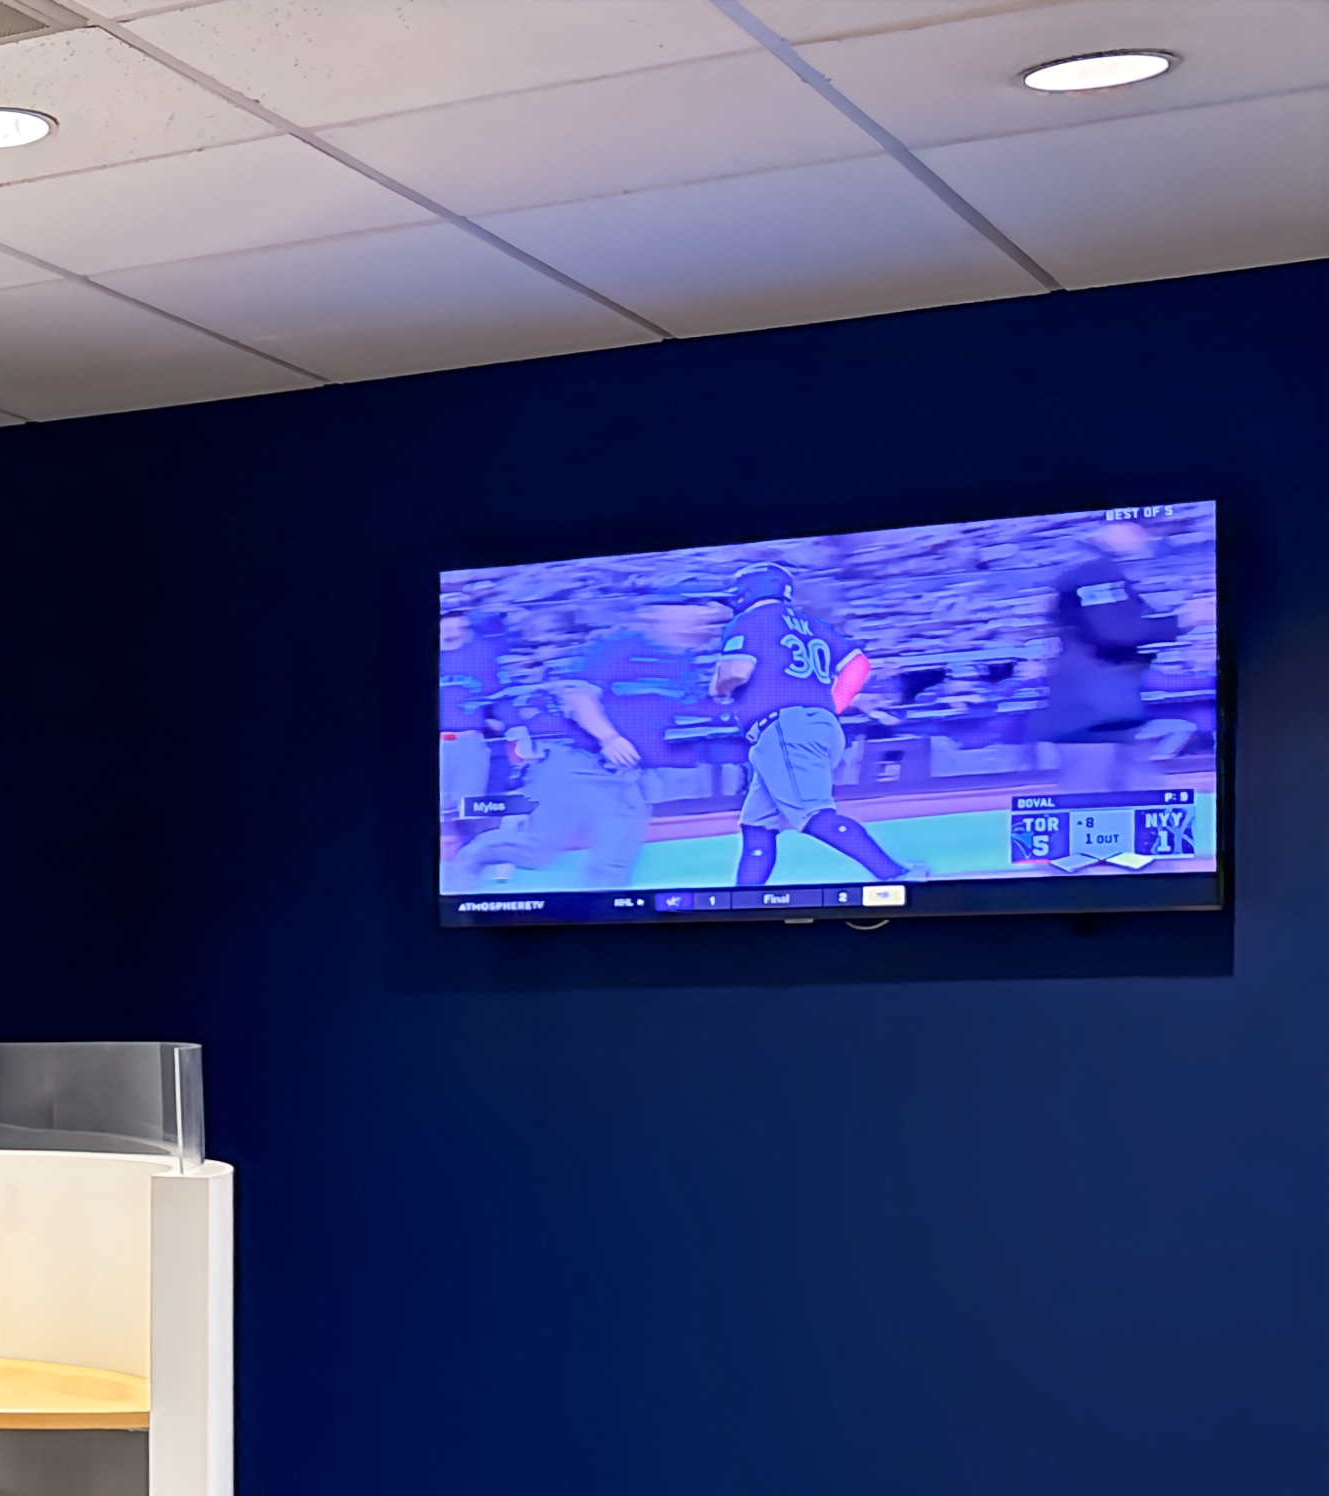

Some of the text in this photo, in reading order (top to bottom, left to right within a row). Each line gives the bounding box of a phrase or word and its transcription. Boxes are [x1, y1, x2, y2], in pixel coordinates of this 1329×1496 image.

[1105, 506, 1140, 521] BEST
[1143, 505, 1161, 518] OF
[780, 633, 831, 684] 30
[1022, 816, 1060, 832] TOR
[1085, 817, 1095, 829] 8
[1145, 811, 1183, 828] NYY
[1032, 835, 1050, 857] 5
[1085, 833, 1120, 845] 1 OUT
[1157, 830, 1171, 852] 1
[763, 893, 791, 904] Final
[838, 892, 848, 903] 2
